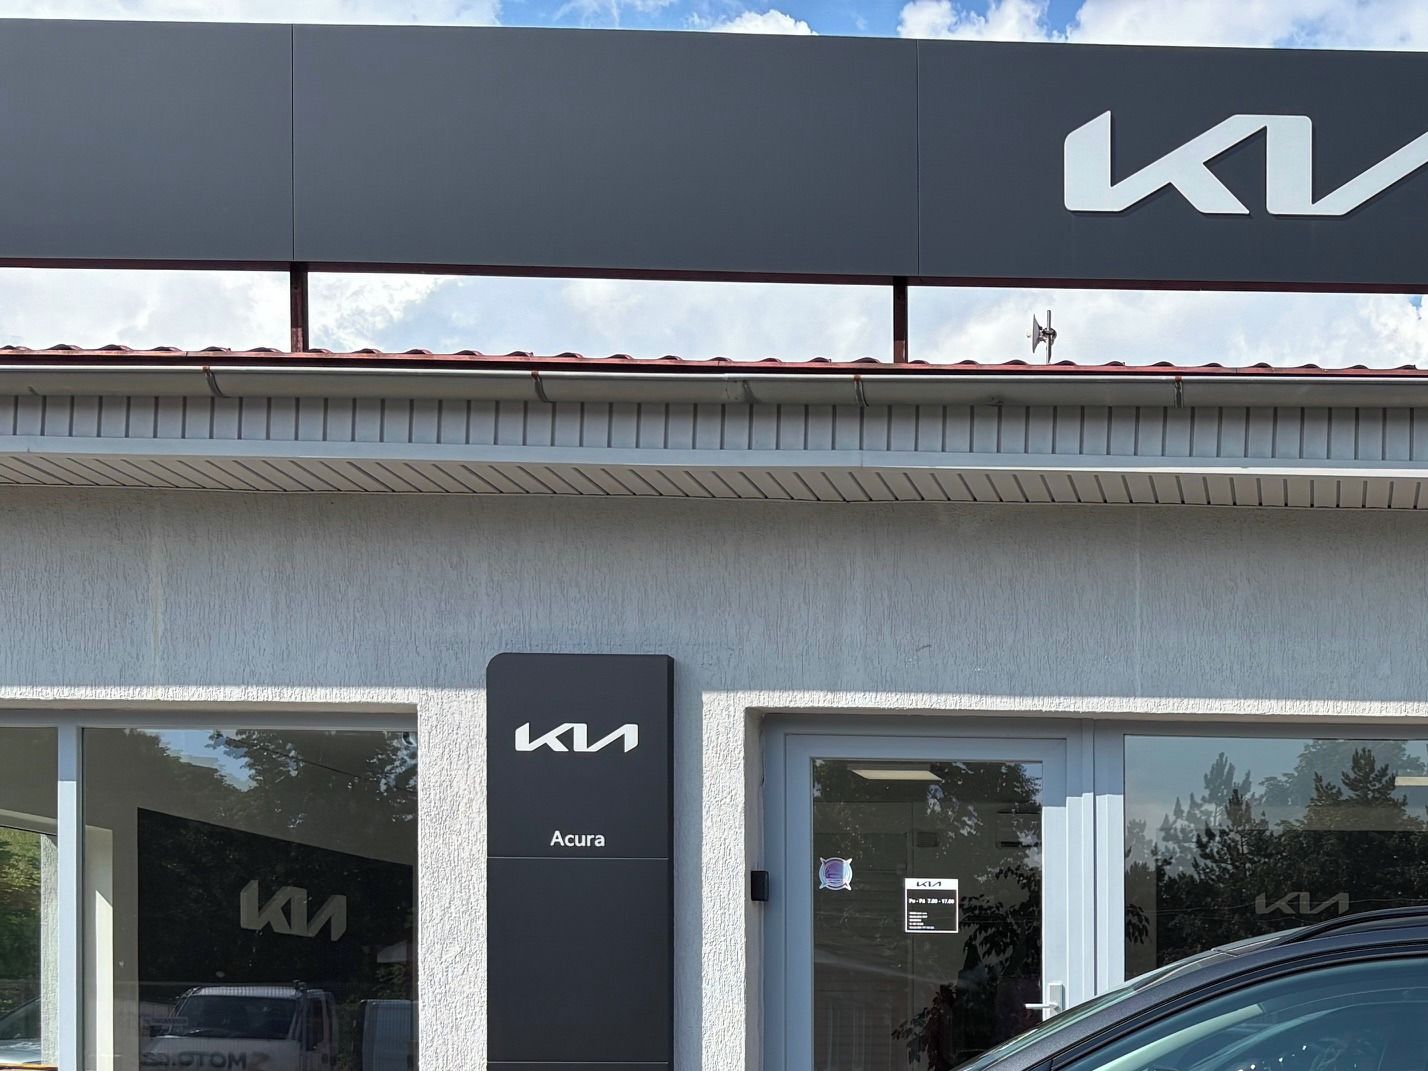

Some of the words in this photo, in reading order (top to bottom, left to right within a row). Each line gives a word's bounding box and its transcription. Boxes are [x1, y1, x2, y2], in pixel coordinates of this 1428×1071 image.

[515, 722, 639, 753] KIA
[550, 830, 605, 847] Acura
[240, 879, 347, 941] KIA
[1255, 891, 1350, 915] KIA
